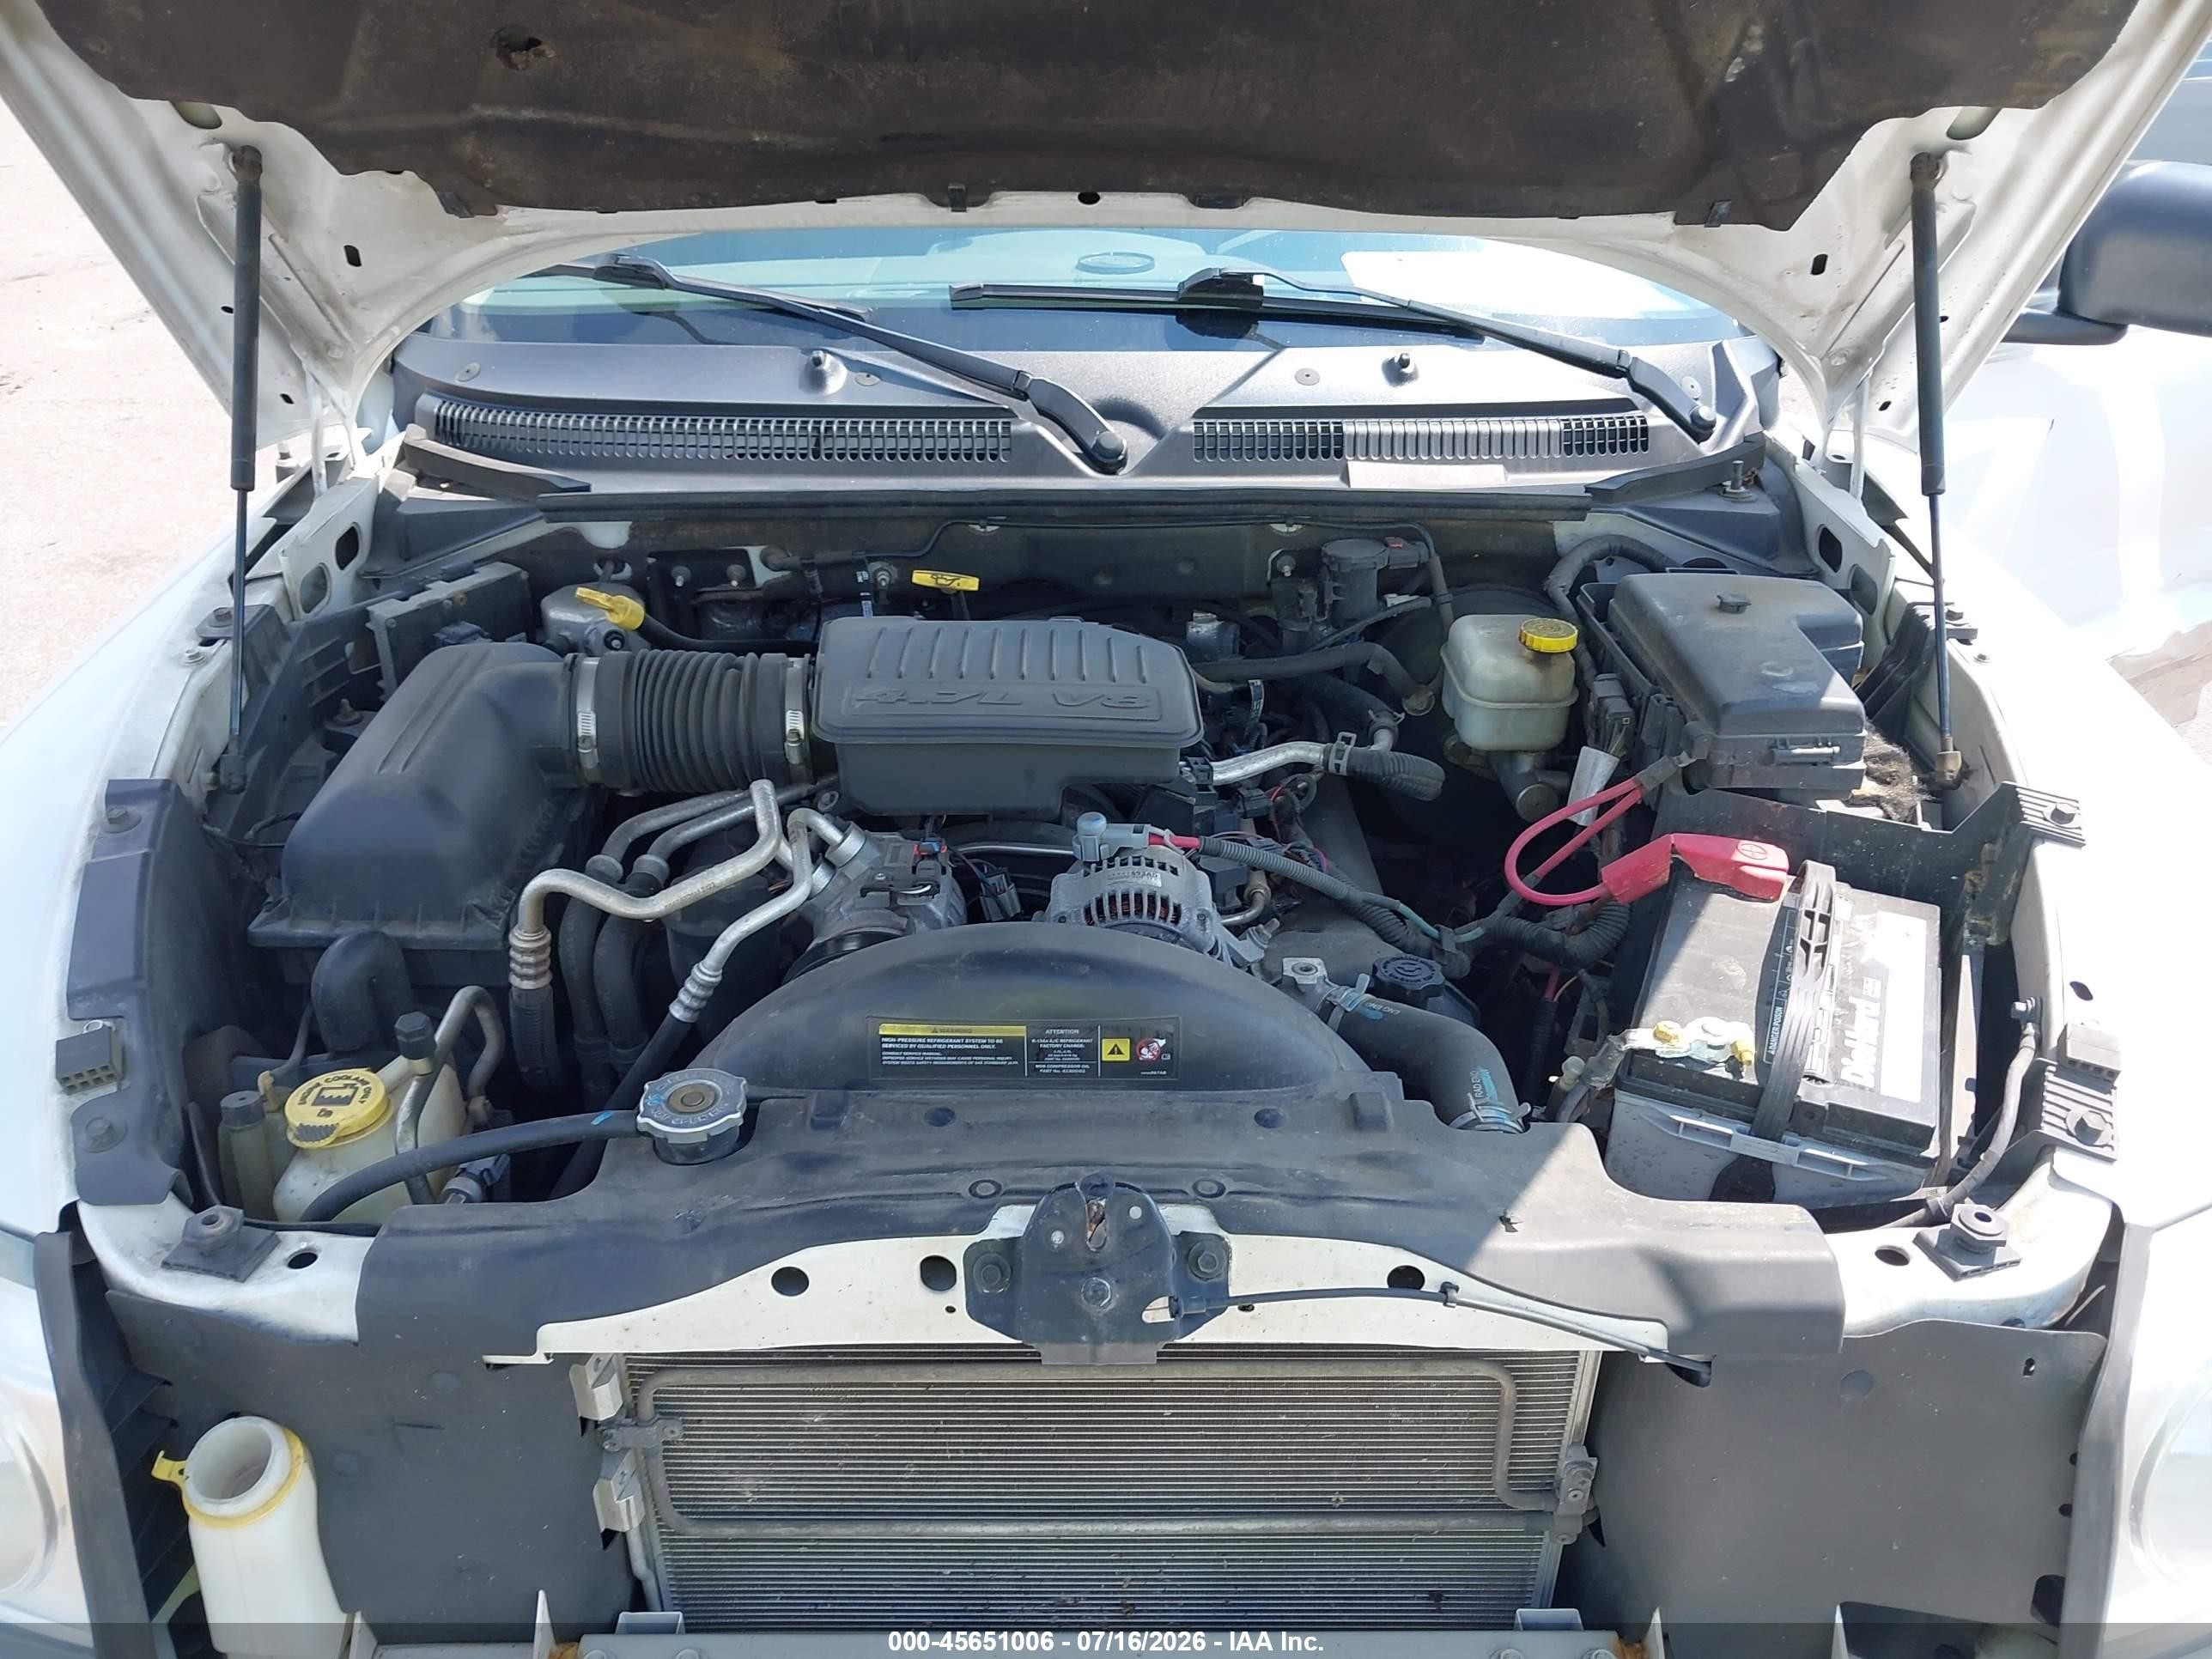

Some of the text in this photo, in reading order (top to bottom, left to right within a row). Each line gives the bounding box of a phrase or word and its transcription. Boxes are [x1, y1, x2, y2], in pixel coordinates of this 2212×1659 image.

[856, 687, 1152, 709] 4.7L V8
[297, 1074, 372, 1106] ENGINE COOLANT ONLY
[1472, 1083, 1485, 1098] RAD
